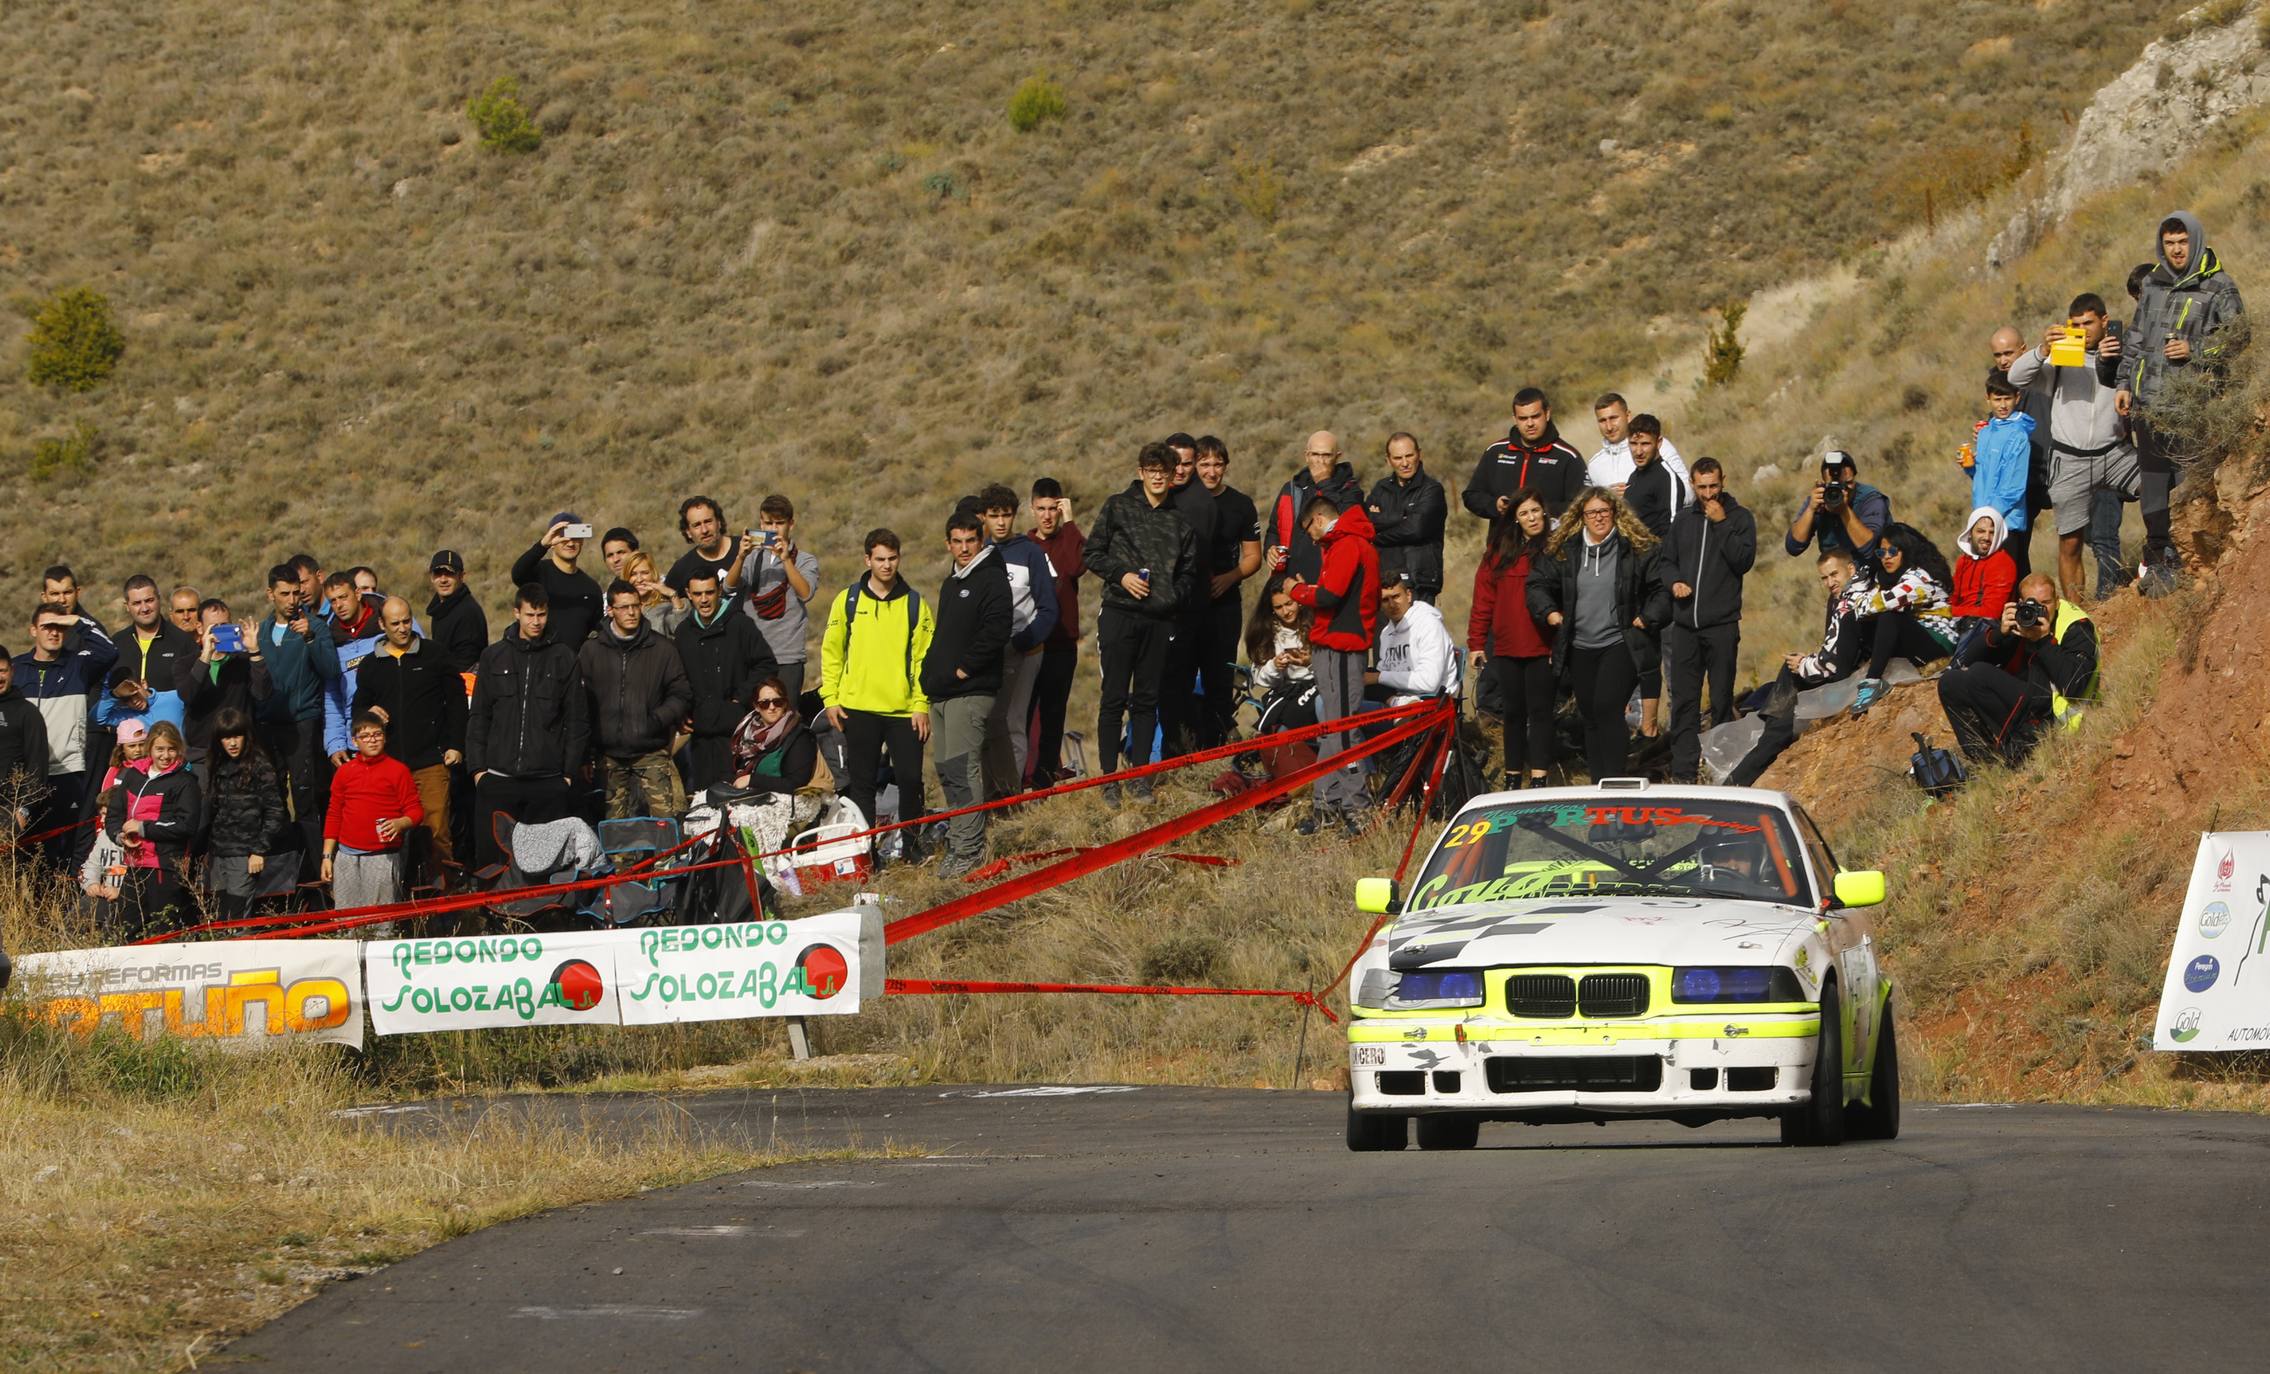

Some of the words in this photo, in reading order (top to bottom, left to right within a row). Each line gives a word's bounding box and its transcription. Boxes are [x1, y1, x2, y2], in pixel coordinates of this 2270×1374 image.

[1444, 820, 1491, 848] 29
[393, 938, 543, 980] REDONDO
[641, 923, 788, 967] REDONDO
[382, 977, 574, 1020] SOLOZABAL
[630, 961, 816, 1009] SOLOZABAL
[2176, 1011, 2201, 1031] Gold
